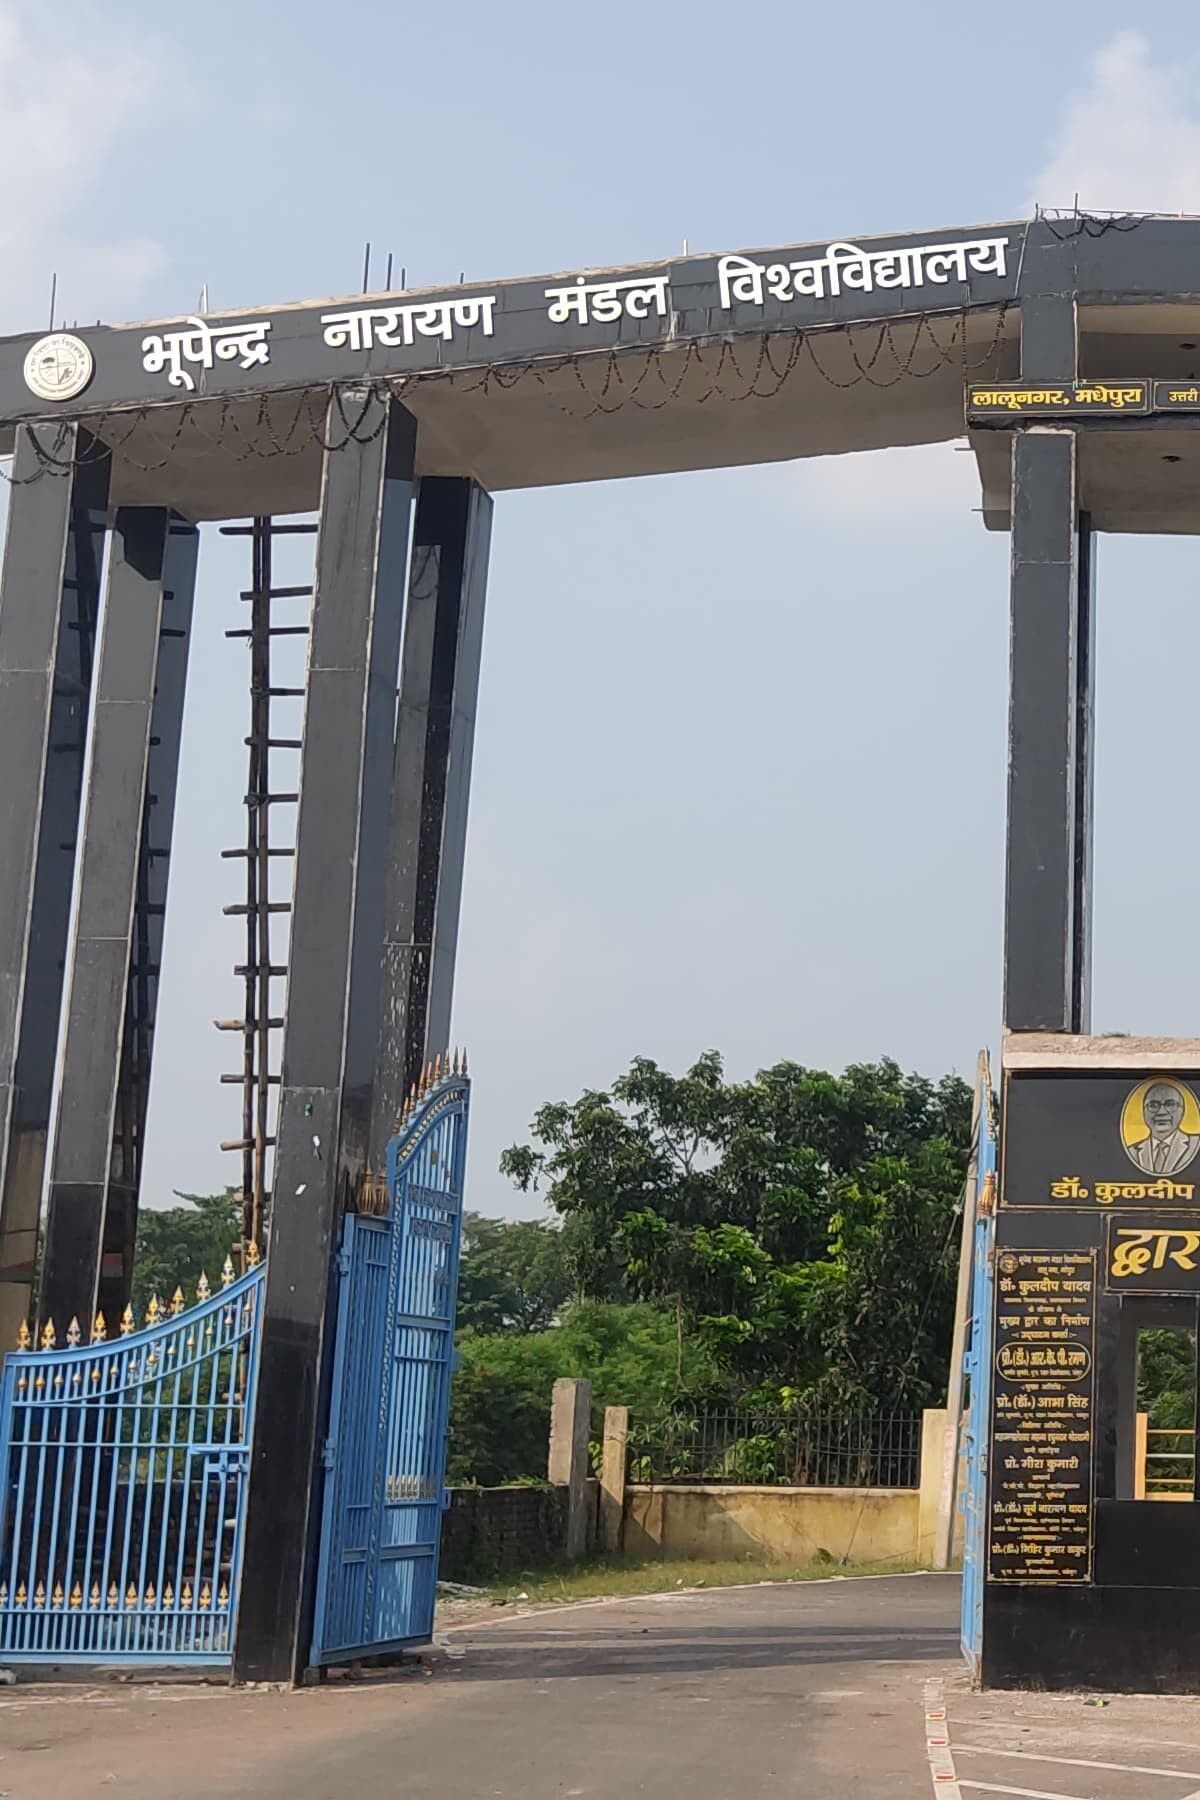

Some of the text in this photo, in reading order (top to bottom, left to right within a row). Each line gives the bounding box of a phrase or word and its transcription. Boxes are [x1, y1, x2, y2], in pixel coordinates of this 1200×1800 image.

[142, 237, 1008, 390] भूपेन्द्र नारायण मंडल विश्वविद्यालय
[972, 386, 1141, 410] लालूनगर, मधेपुरा
[1169, 389, 1197, 403] उत्तरी
[1095, 1178, 1195, 1204] कुलदीप
[1018, 1277, 1059, 1295] कुलदीप
[1063, 1280, 1091, 1292] यादव
[1047, 1455, 1079, 1472] कुमारी
